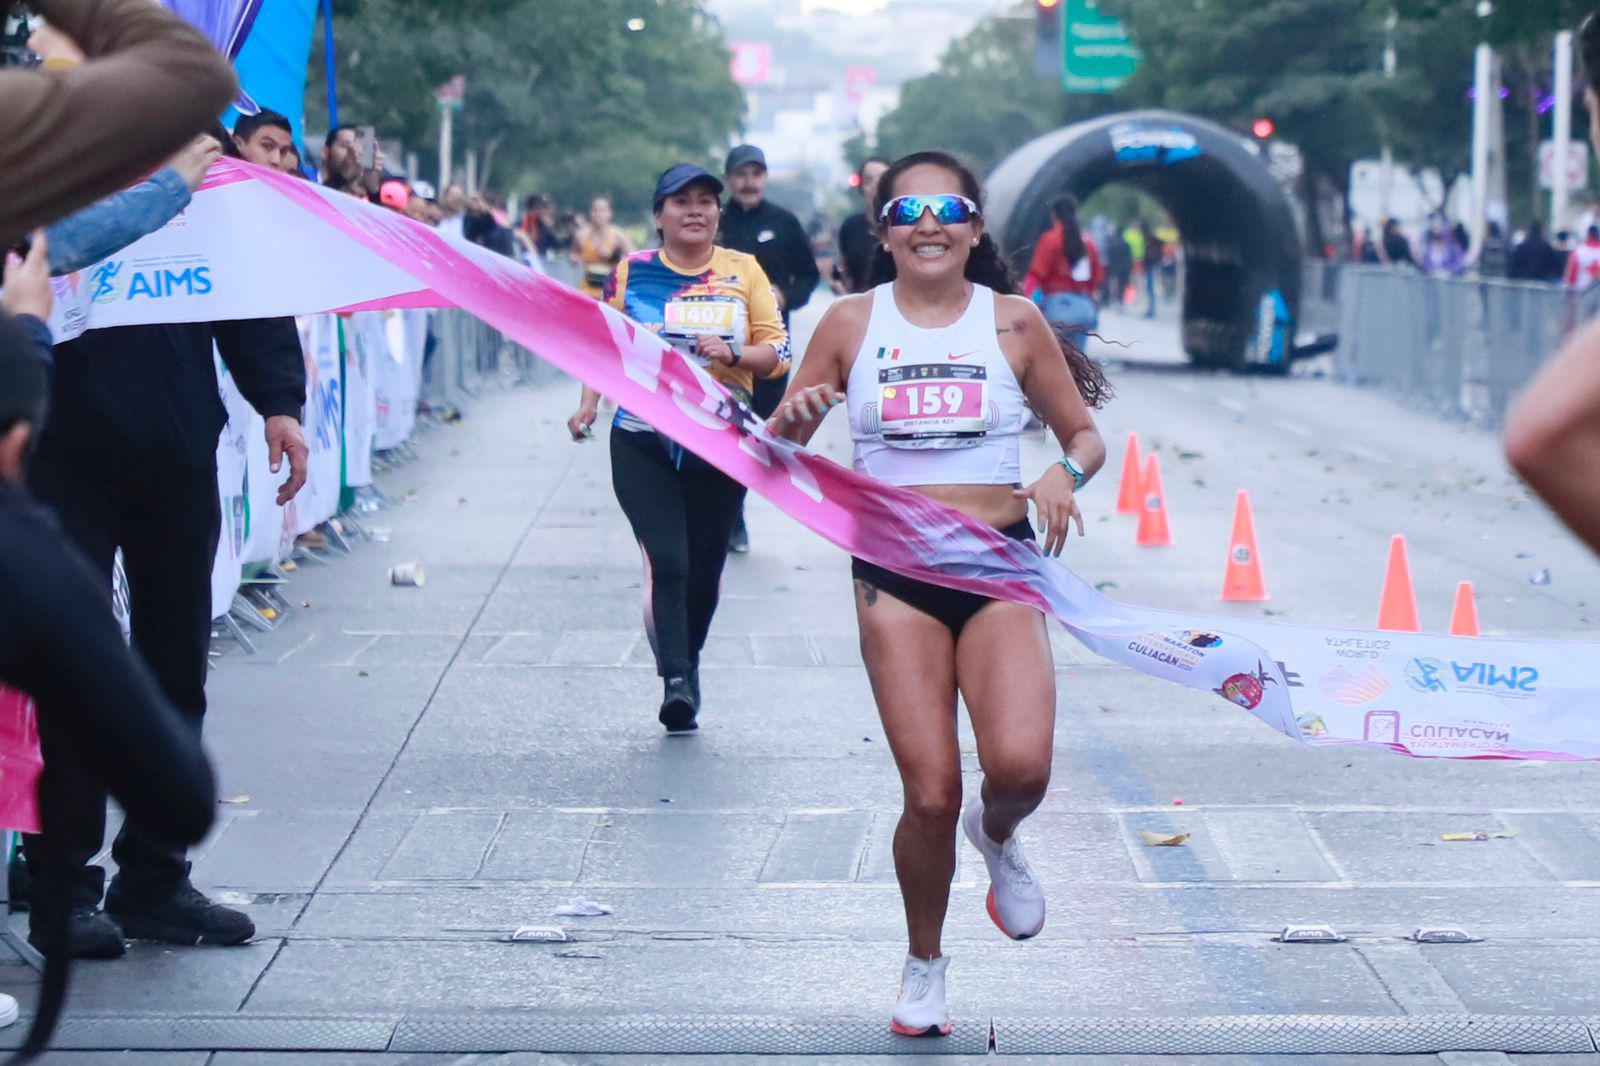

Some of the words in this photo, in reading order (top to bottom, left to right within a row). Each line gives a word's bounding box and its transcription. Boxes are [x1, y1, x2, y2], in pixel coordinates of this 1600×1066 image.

[127, 266, 212, 300] AIMS
[677, 305, 729, 325] 1407
[906, 385, 964, 416] 159
